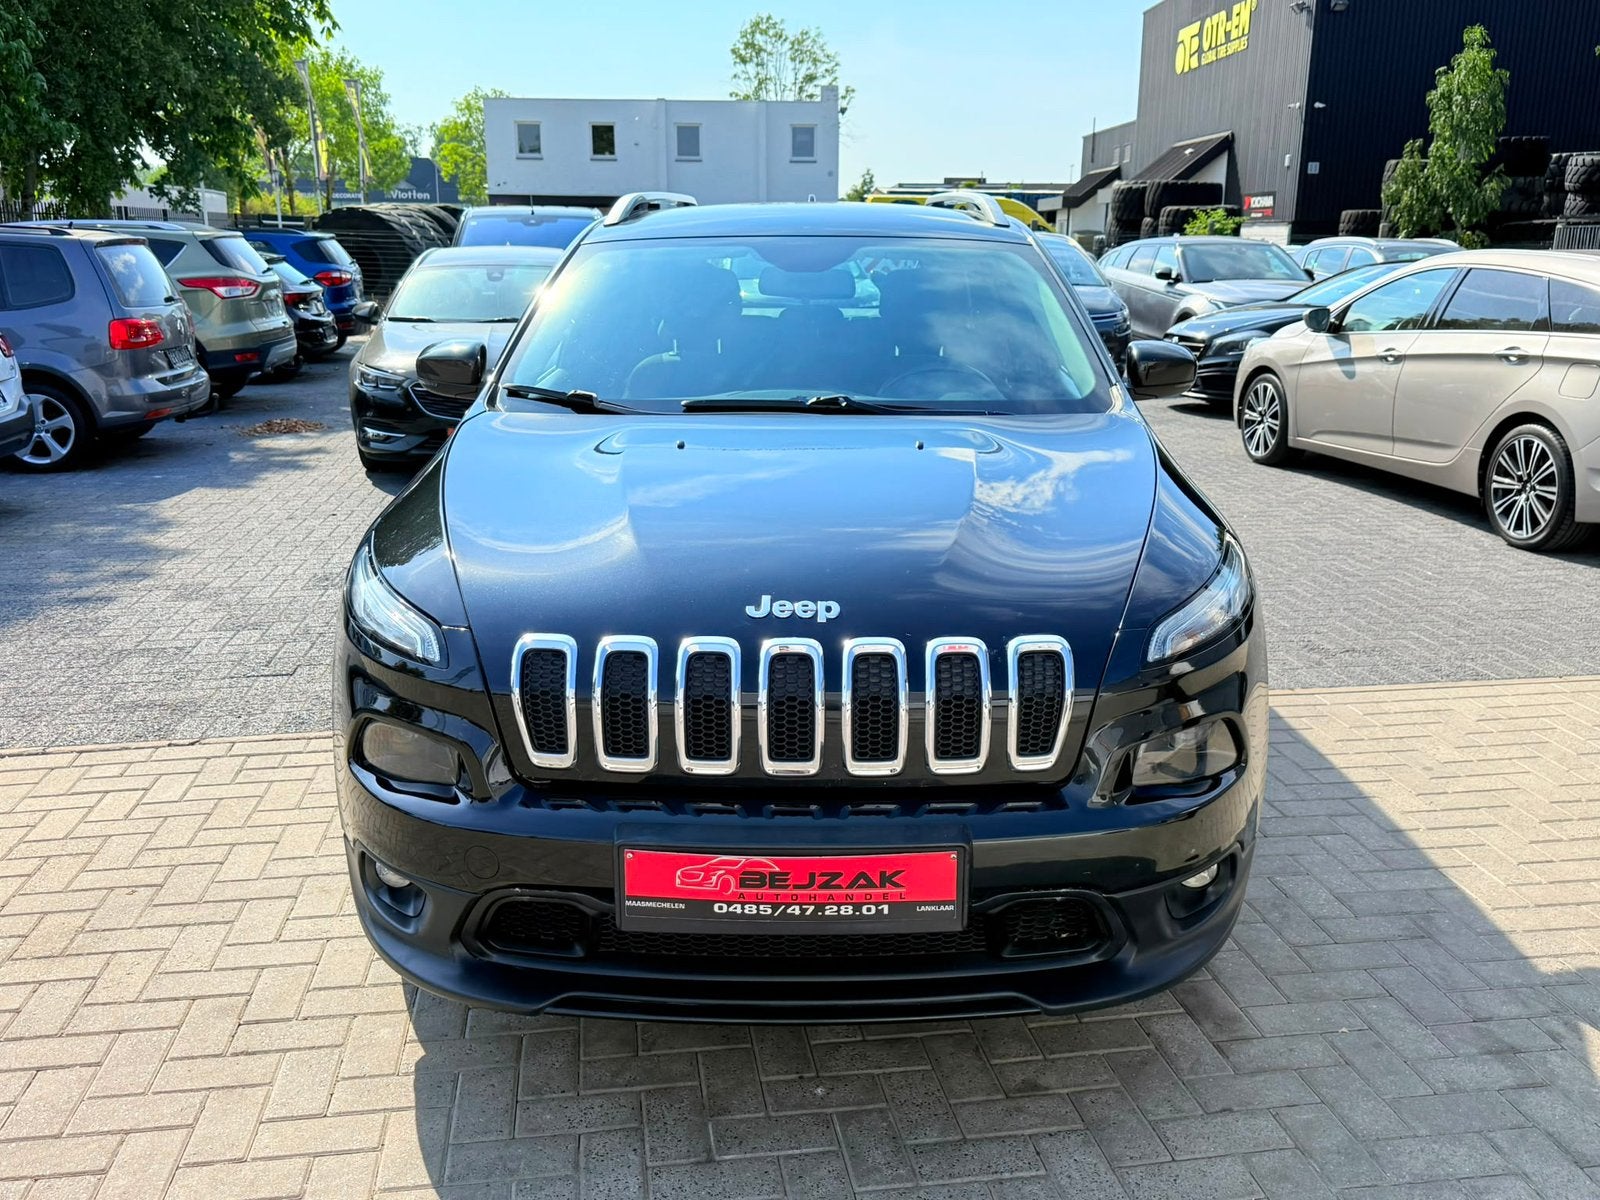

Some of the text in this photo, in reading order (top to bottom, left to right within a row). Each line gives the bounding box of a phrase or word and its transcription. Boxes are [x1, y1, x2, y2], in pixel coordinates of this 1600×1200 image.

[745, 595, 841, 623] Jeep
[739, 869, 906, 890] BEJZAK
[737, 891, 906, 902] AUTOHANDEL
[625, 900, 686, 910] MAASMECHELEN
[713, 902, 890, 917] 0485/47.28.01
[916, 904, 955, 913] LANKLAAR
